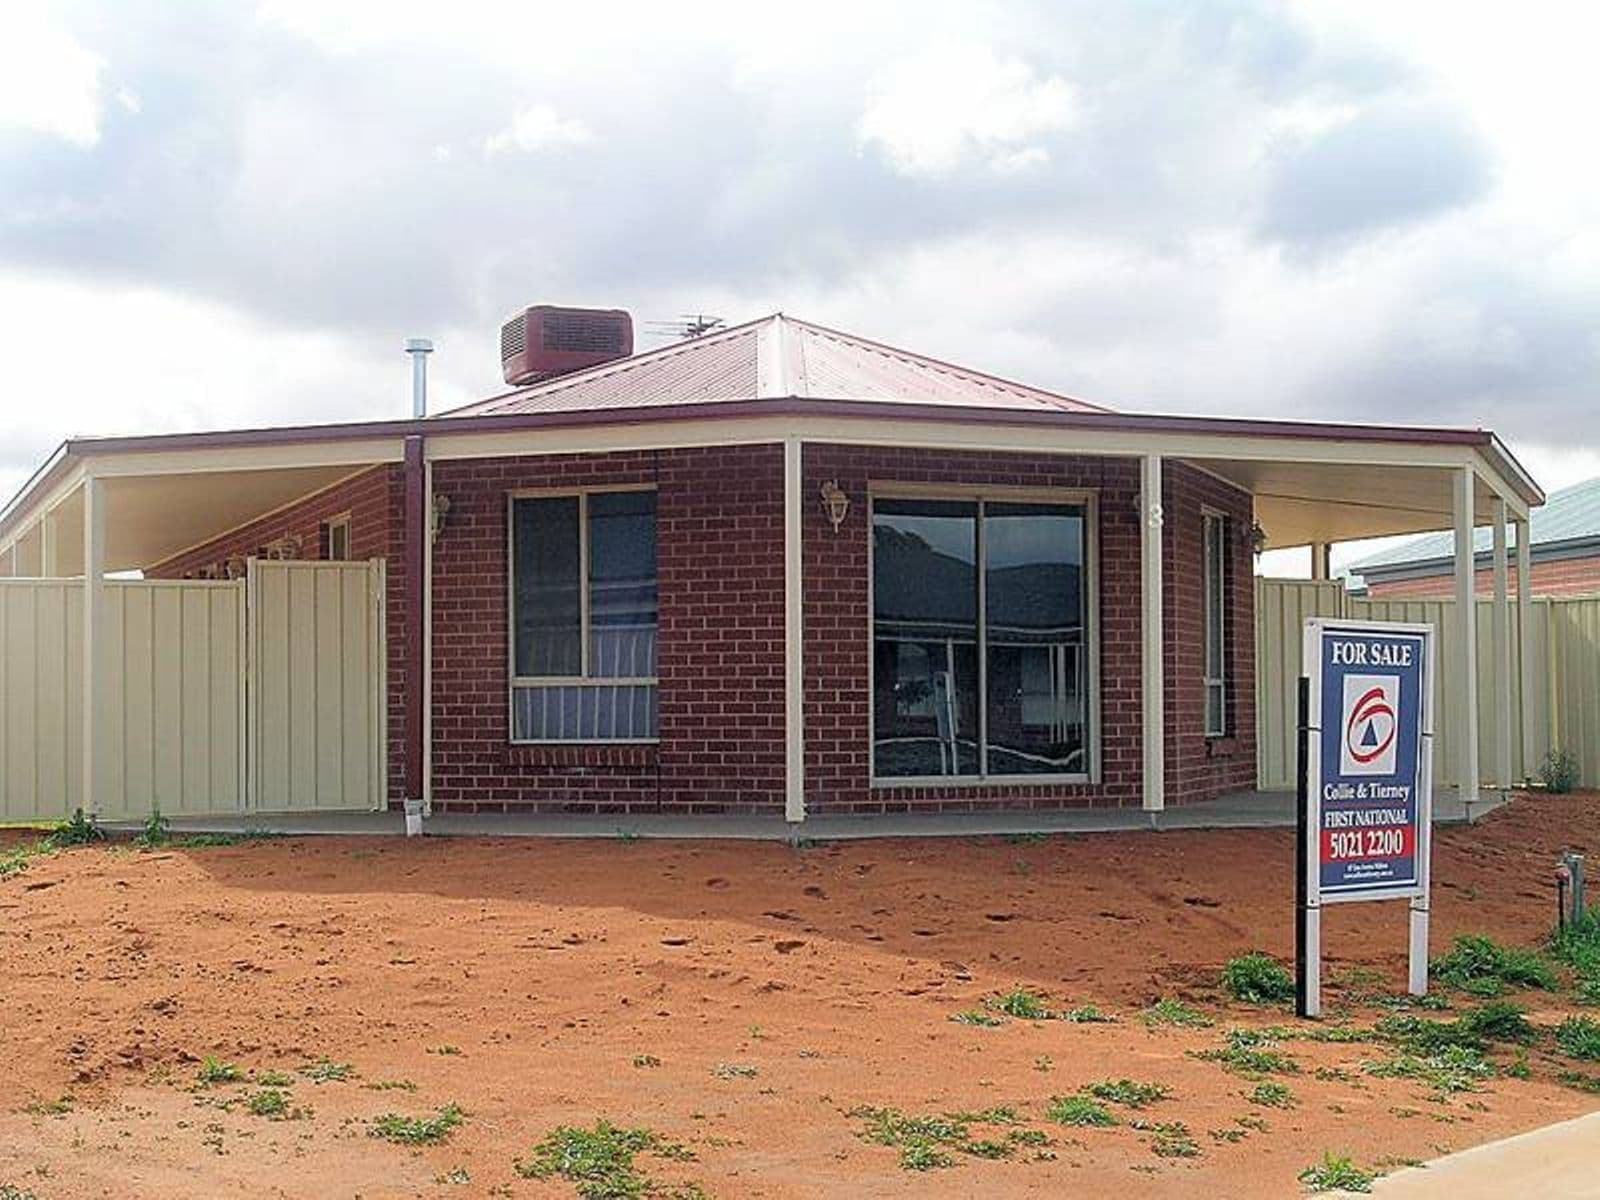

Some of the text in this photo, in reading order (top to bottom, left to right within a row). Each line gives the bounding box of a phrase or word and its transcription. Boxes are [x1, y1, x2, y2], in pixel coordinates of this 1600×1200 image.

[1331, 641, 1412, 666] FOR SALE
[1324, 782, 1409, 802] Collie & Tierney
[1325, 808, 1408, 828] FIRST NATIONAL
[1330, 829, 1403, 858] 5021 2200
